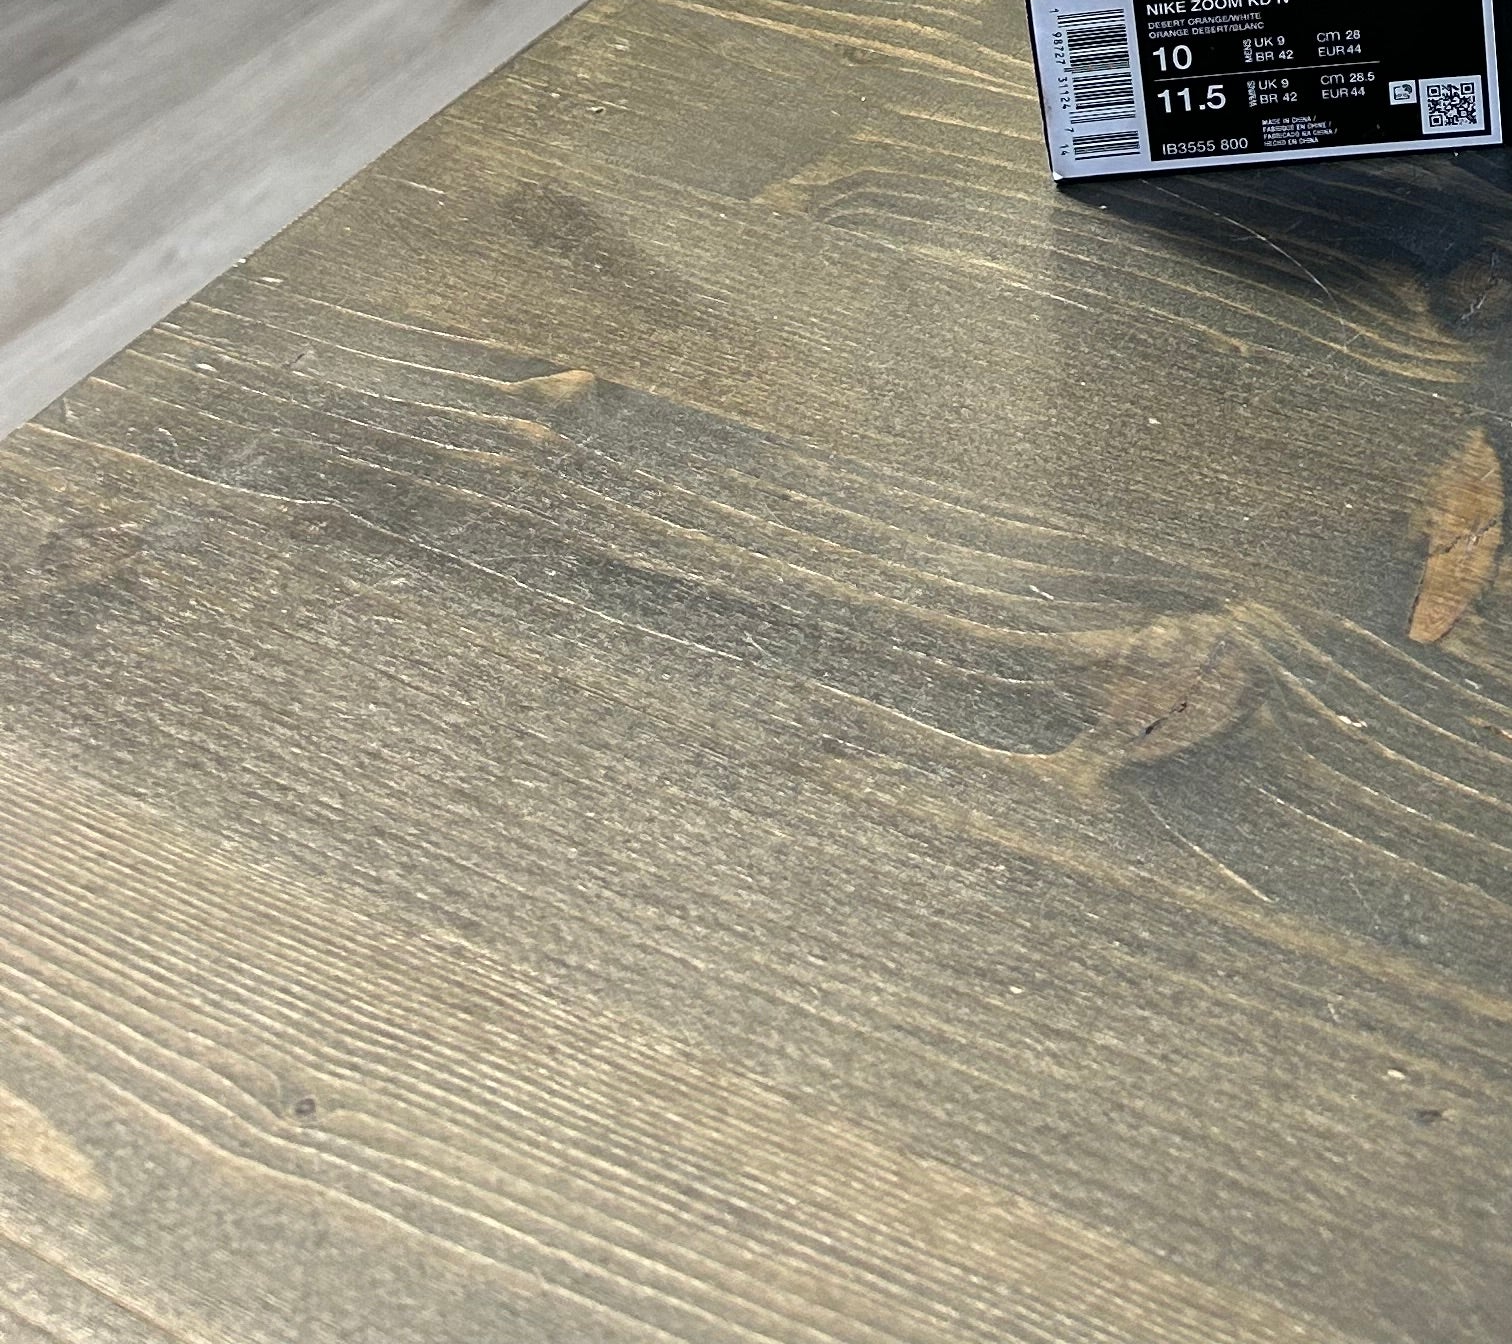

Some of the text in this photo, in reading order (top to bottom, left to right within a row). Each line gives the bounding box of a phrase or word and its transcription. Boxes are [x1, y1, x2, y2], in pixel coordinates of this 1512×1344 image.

[1146, 1, 1186, 16] NIKE
[1148, 19, 1185, 29] DESERT
[1149, 28, 1189, 39] ORANGE
[1345, 30, 1361, 40] 28
[1254, 35, 1285, 48] UK 9
[1255, 49, 1294, 62] BR 42
[1318, 44, 1362, 57] EUR 44
[1153, 44, 1192, 71] 10
[1258, 78, 1289, 90] UK 9
[1349, 72, 1375, 83] 28.5
[1057, 76, 1071, 111] 31124
[1157, 85, 1226, 113] 11.5
[1259, 91, 1298, 104] BR 42
[1321, 86, 1366, 99] EUR 44
[1162, 137, 1248, 156] IB3555 800
